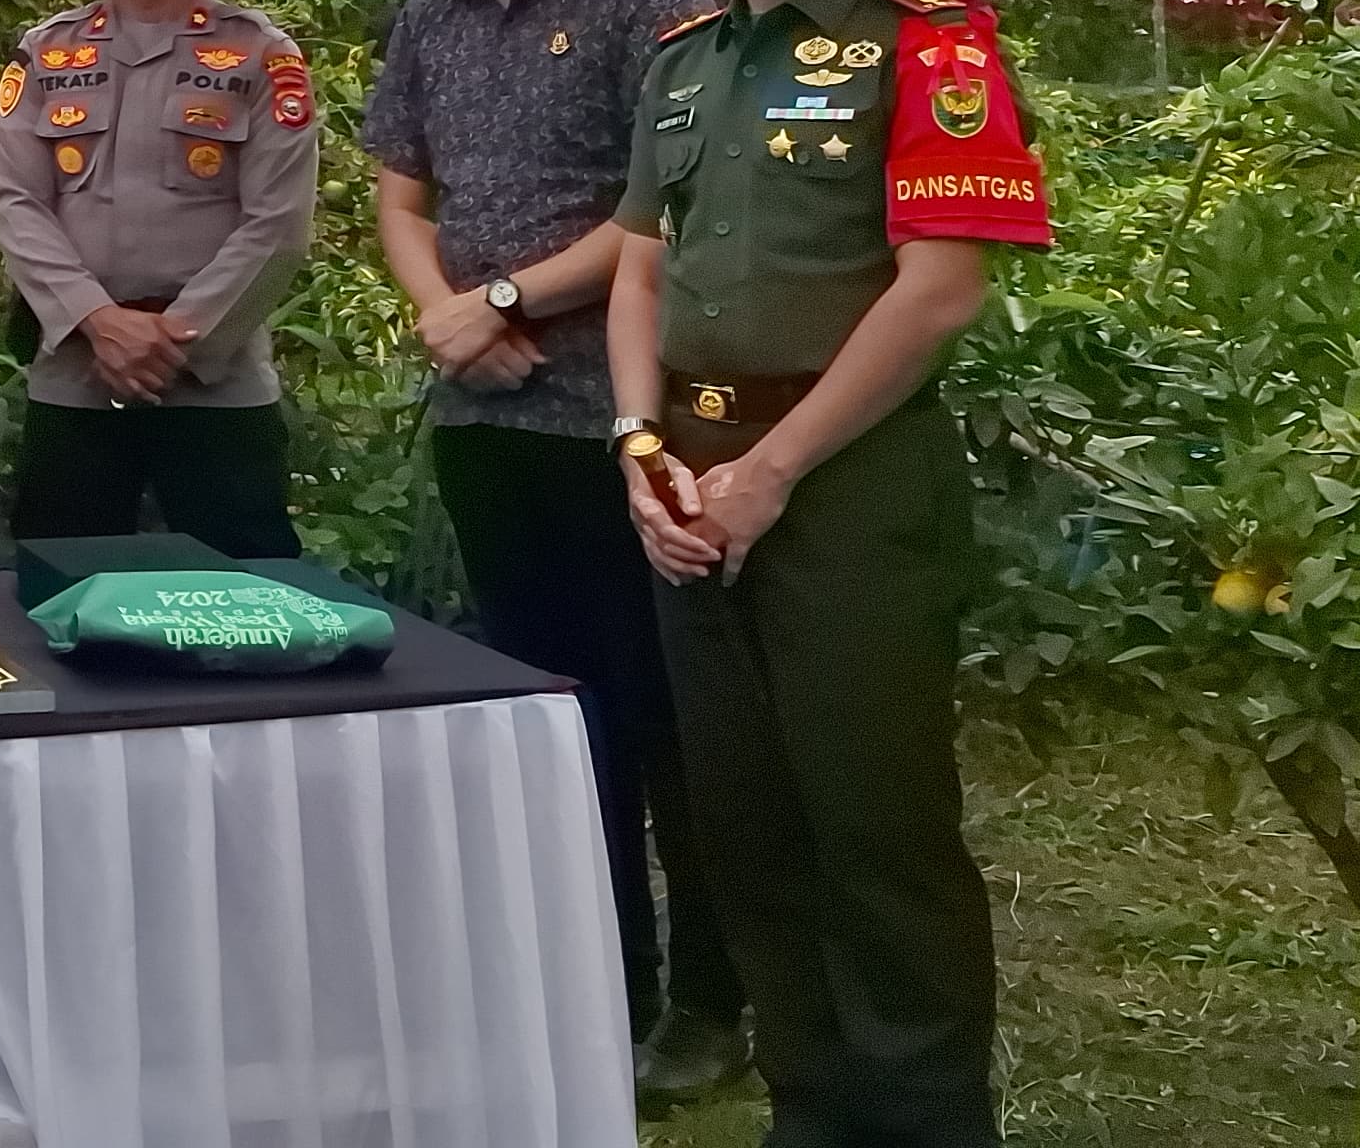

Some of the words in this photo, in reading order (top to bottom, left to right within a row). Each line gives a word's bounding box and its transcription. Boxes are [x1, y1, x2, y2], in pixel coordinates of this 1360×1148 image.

[176, 70, 251, 95] POLRI
[896, 174, 1035, 203] DANSATGAS
[155, 589, 232, 608] 2024
[120, 610, 218, 628] Wisata
[215, 611, 290, 628] Desa
[163, 623, 294, 651] Anugerah
